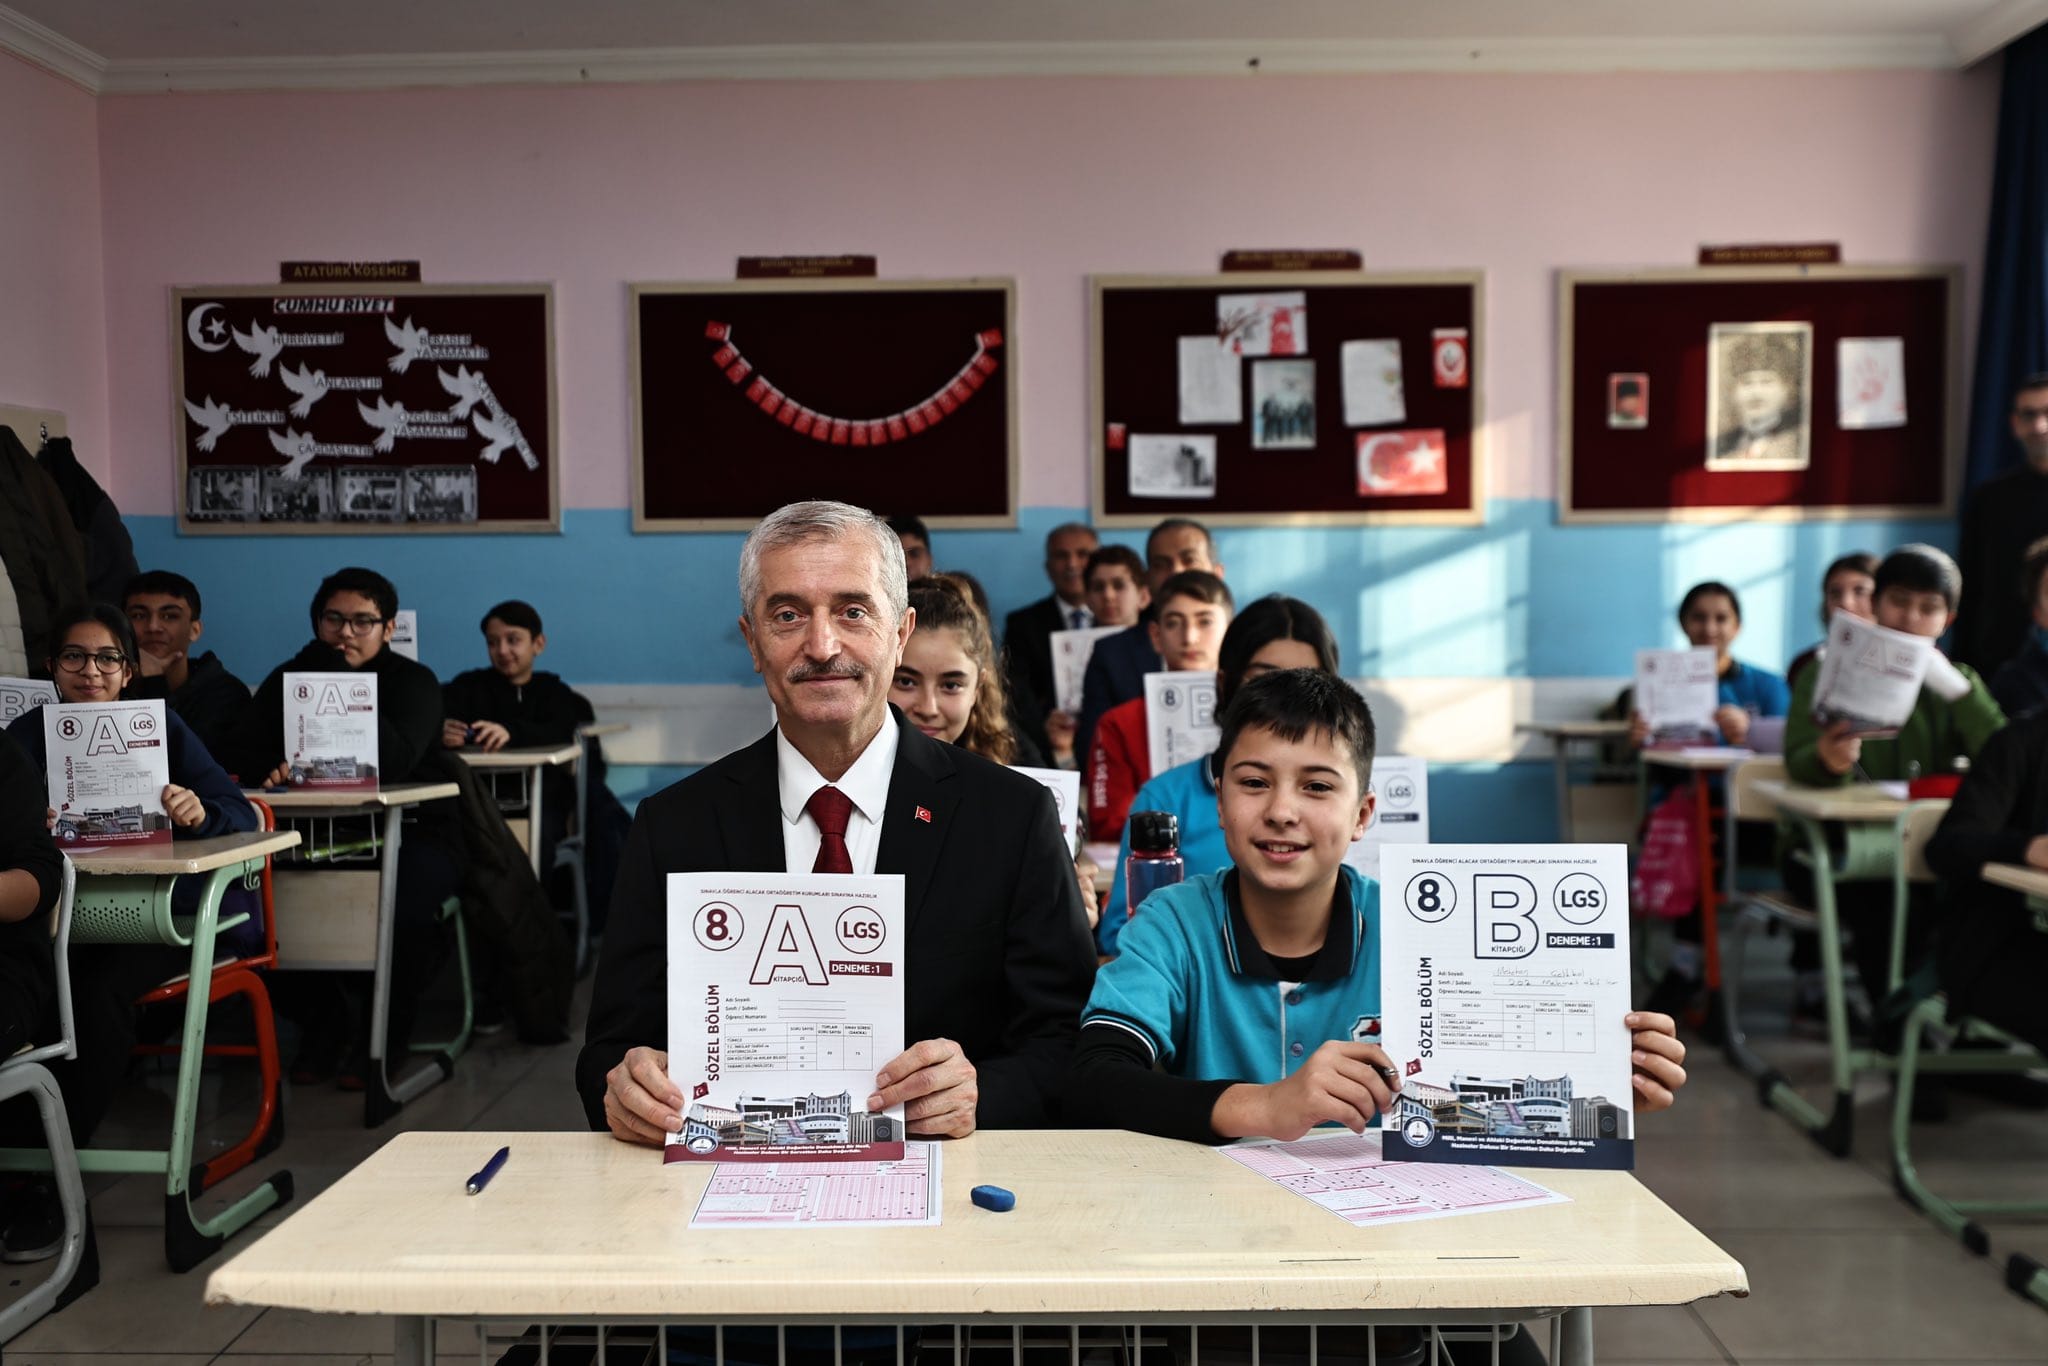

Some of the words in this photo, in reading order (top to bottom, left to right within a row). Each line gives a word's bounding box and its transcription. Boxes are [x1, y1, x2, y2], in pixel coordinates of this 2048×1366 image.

[294, 264, 351, 277] ATATÜRK
[315, 683, 347, 716] A
[63, 719, 78, 736] 8.
[86, 715, 128, 756] A
[133, 720, 153, 730] LGS
[1388, 785, 1412, 799] LGS
[1417, 878, 1445, 912] 8.
[1561, 890, 1600, 908] LGS
[706, 909, 733, 941] 8.
[843, 921, 880, 939] LGS
[1474, 873, 1539, 959] B
[749, 904, 829, 985] A
[1491, 945, 1526, 953] KİTAPÇIĞI
[1417, 957, 1432, 1007] BÖLÜM
[705, 984, 719, 1034] BÖLÜM
[1418, 1012, 1433, 1058] SÖZEL
[705, 1038, 720, 1081] SÖZEL
